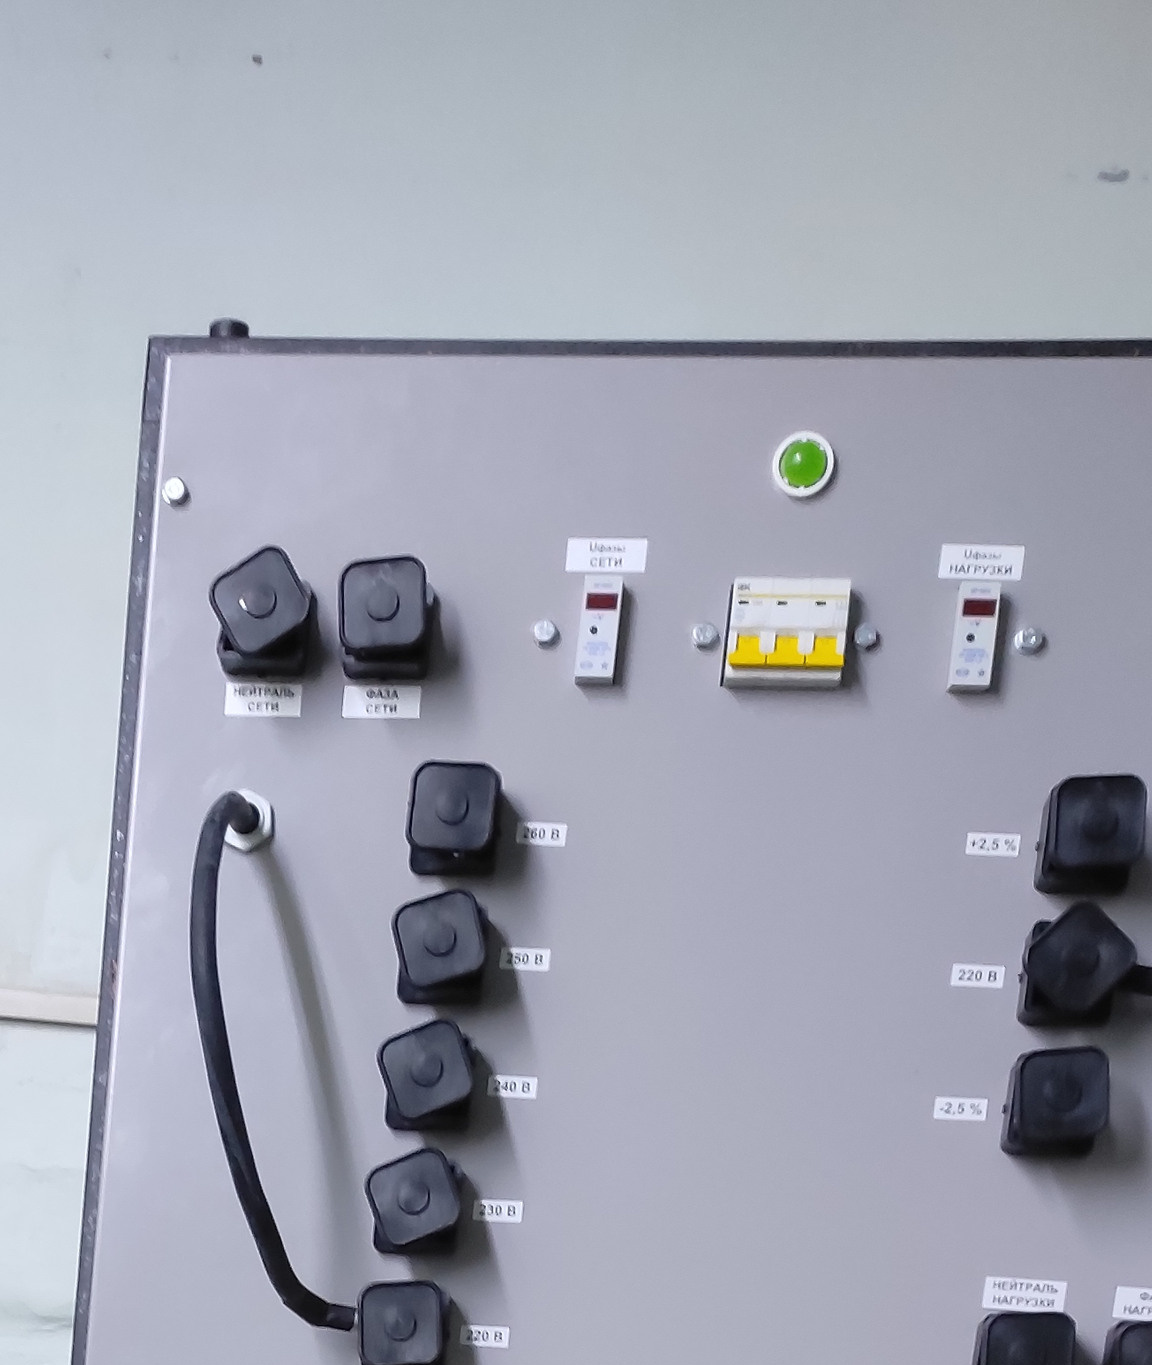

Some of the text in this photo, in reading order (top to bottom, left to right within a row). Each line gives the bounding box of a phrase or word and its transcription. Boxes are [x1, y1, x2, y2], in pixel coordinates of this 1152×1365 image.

[589, 557, 623, 568] СЕТИ
[949, 564, 1013, 576] НАГРУЗКИ
[365, 688, 400, 700] ФАЗА
[247, 701, 280, 713] СЕТИ
[365, 702, 398, 714] СЕТИ
[523, 827, 546, 840] 260
[1004, 838, 1016, 851] %
[506, 952, 529, 965] 250
[958, 968, 983, 982] 220
[493, 1079, 517, 1093] 240
[970, 1102, 982, 1115] %
[479, 1203, 503, 1217] 230
[992, 1279, 1059, 1294] НЕЙТРАЛЬ
[992, 1295, 1055, 1308] НАГРУЗКИ
[466, 1329, 490, 1342] 220
